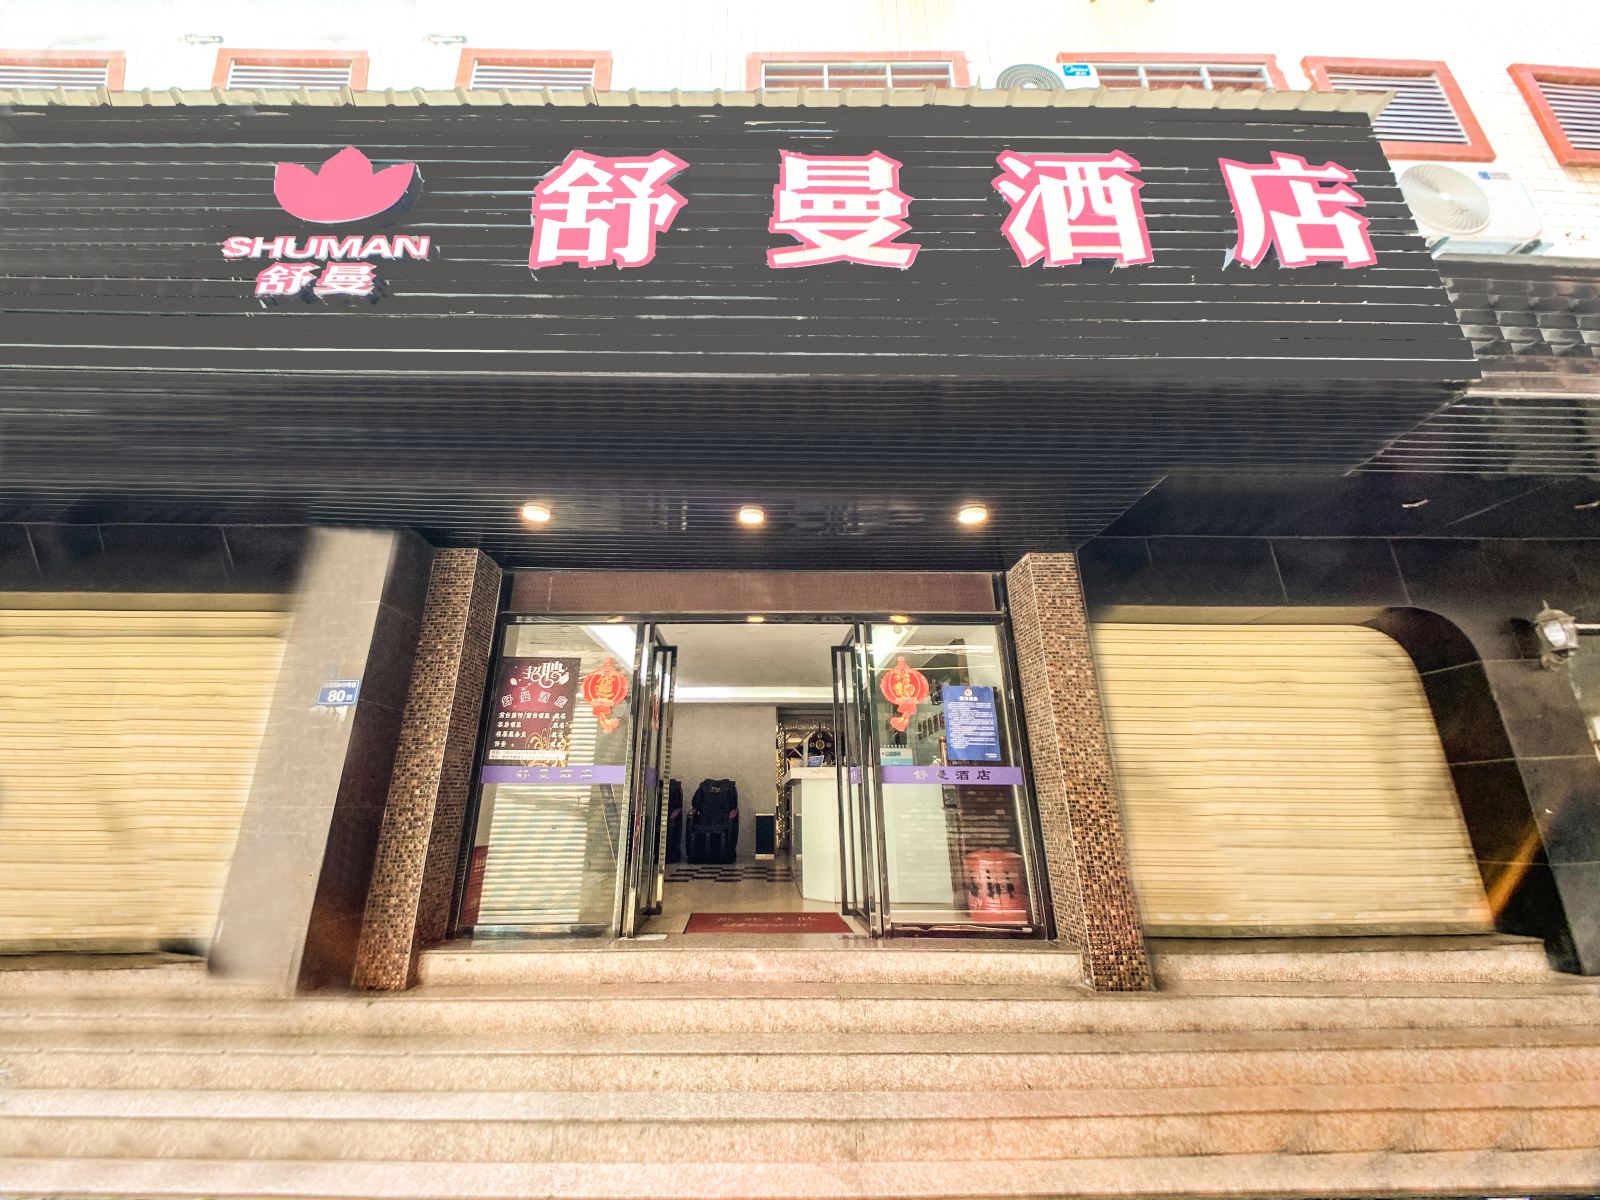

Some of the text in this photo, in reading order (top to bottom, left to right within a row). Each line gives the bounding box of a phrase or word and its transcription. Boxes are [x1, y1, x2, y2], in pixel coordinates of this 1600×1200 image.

[529, 150, 1377, 269] 舒曼酒店
[221, 235, 431, 259] SHUMAN
[254, 262, 378, 296] 舒曼
[523, 661, 566, 688] 招聘
